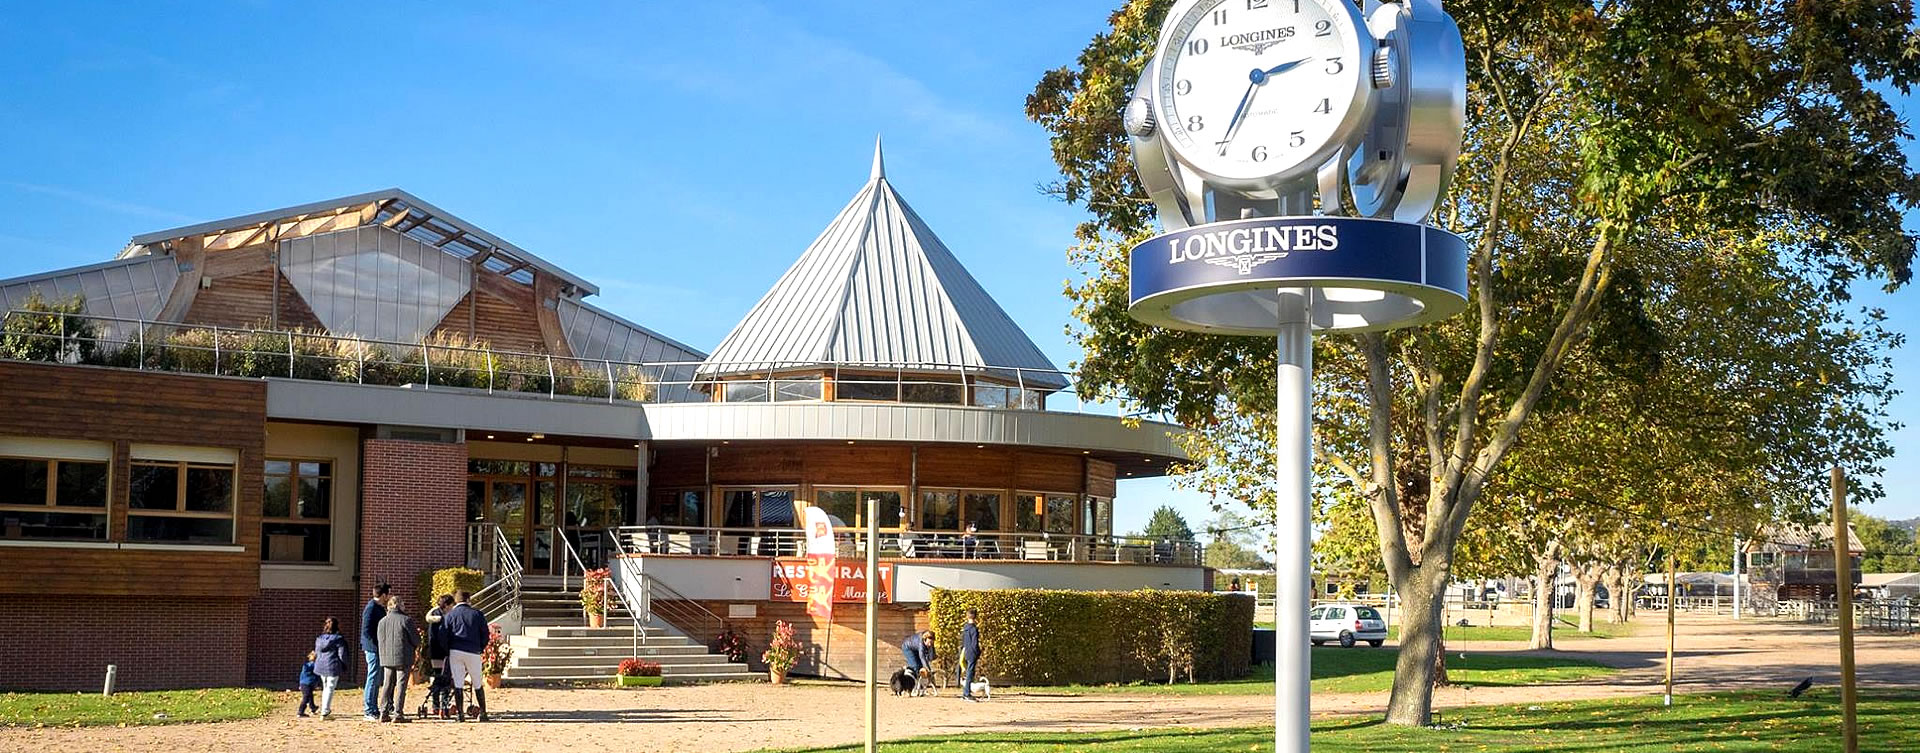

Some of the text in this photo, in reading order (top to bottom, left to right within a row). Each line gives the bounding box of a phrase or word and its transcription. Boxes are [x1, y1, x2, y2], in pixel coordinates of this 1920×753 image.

[1213, 9, 1227, 26] 11
[1220, 26, 1296, 47] LONGINES
[1315, 19, 1332, 37] 2
[1187, 38, 1209, 56] 10
[1325, 57, 1344, 75] 3
[1176, 79, 1192, 96] 9
[1312, 97, 1333, 114] 4
[1187, 115, 1204, 132] 8
[1289, 129, 1306, 148] 5
[1251, 145, 1268, 163] 6
[1168, 224, 1338, 264] LONGINES
[773, 565, 890, 579] RESTRAT
[774, 583, 792, 597] Le
[842, 586, 888, 603] Mane
